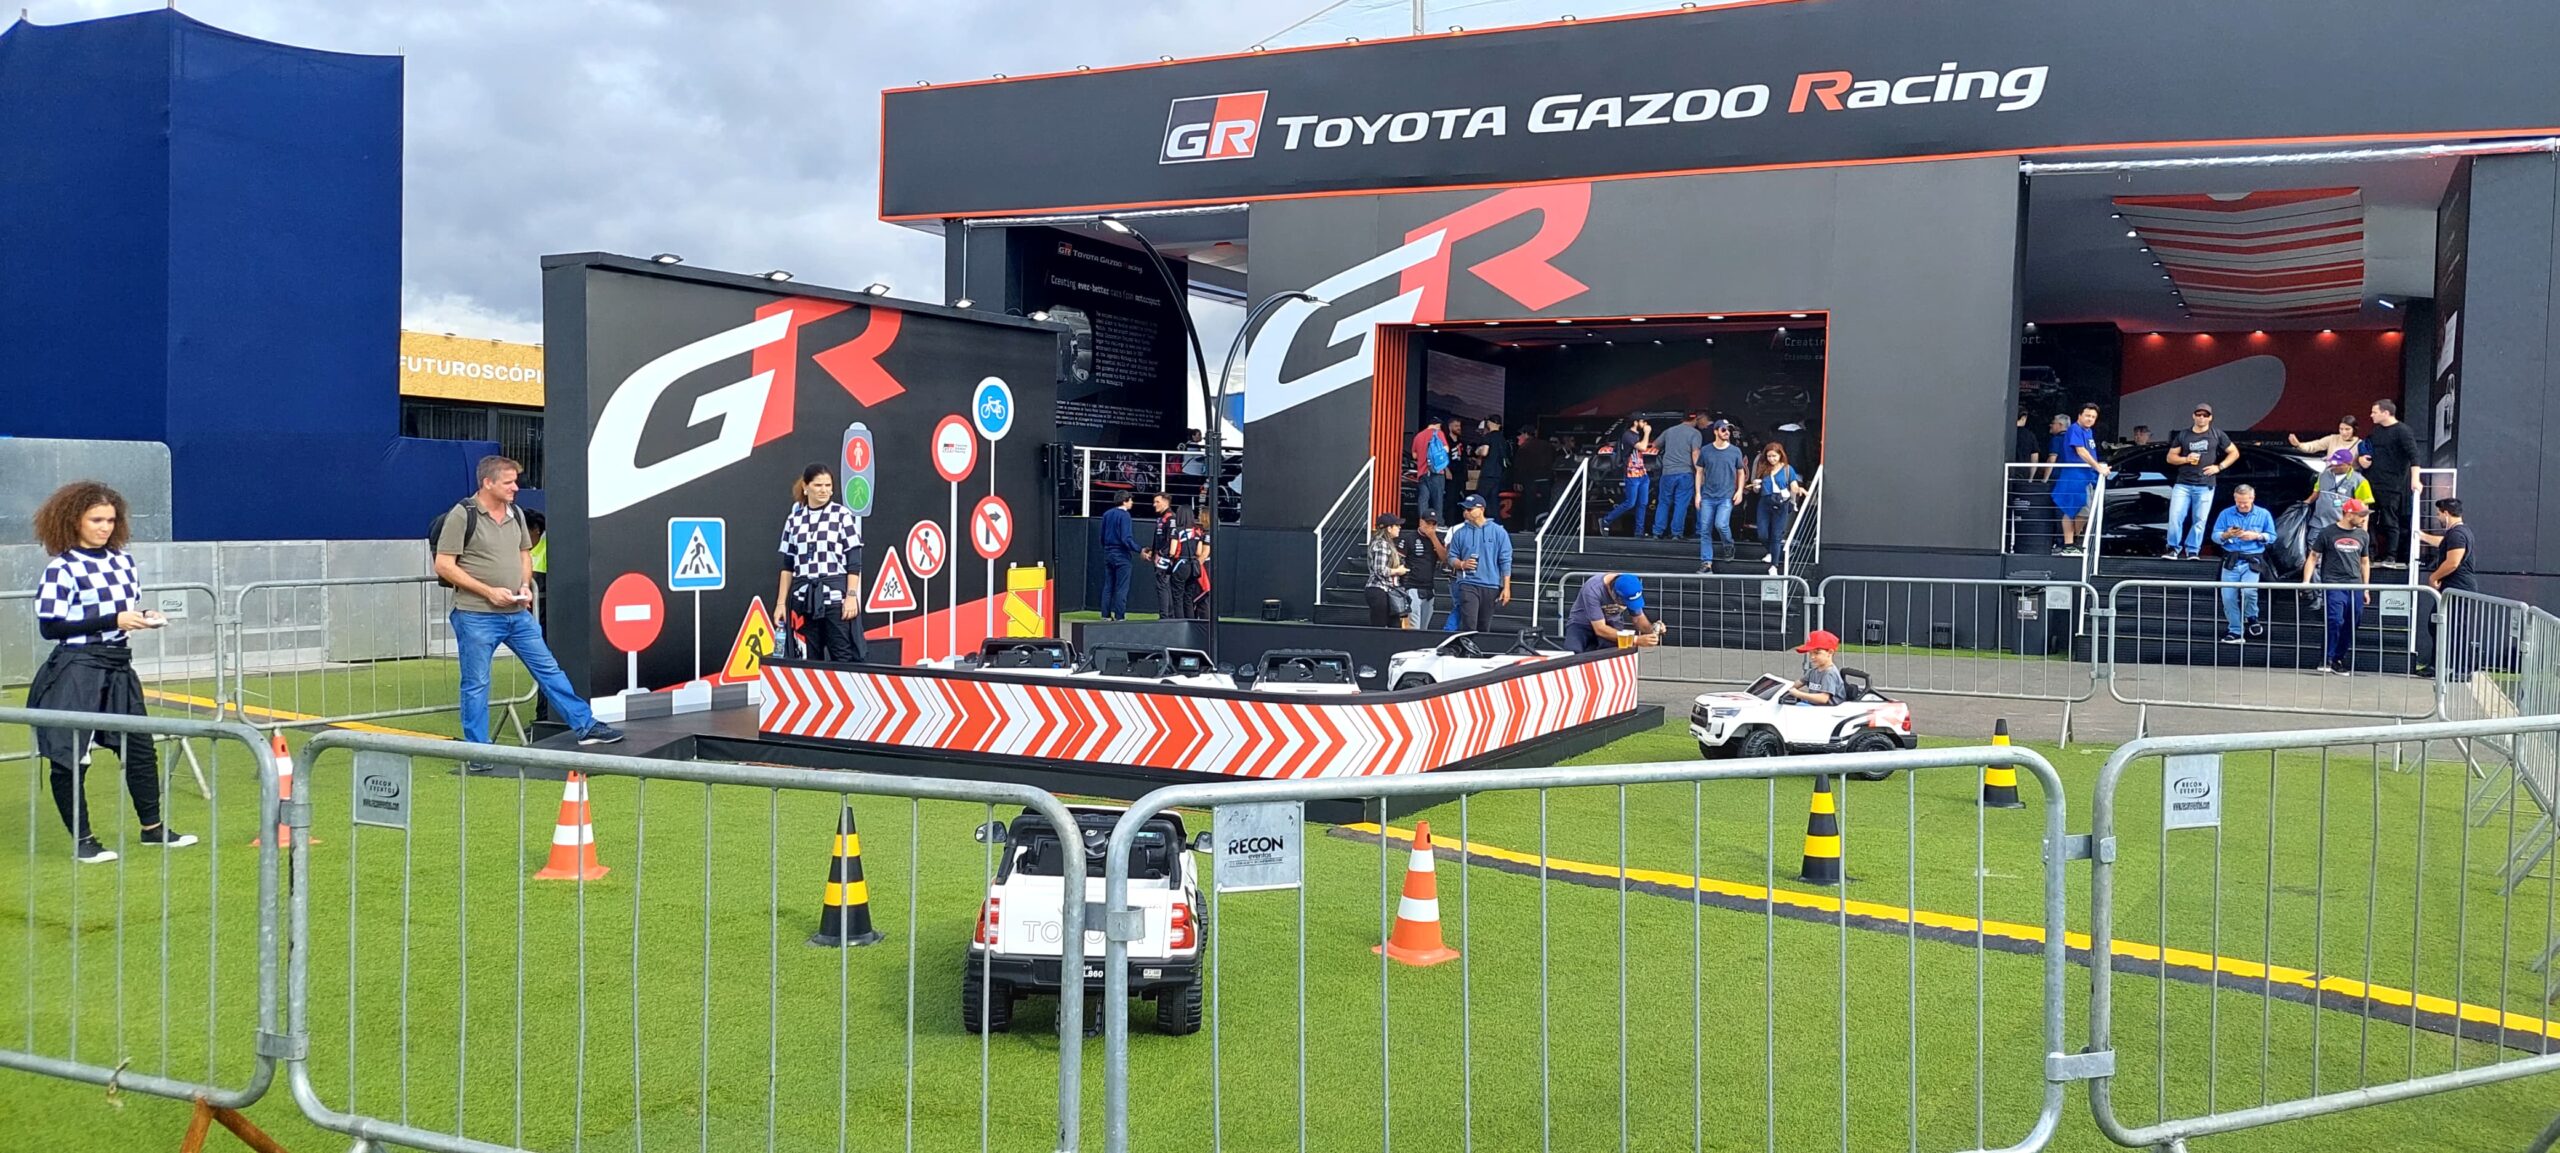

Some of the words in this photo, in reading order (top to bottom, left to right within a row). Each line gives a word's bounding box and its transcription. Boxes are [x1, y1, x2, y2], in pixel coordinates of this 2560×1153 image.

[1165, 117, 1257, 160] GR
[1276, 105, 1506, 150] TOYOTA
[1527, 83, 1770, 134] GAZOO
[1787, 62, 2050, 114] Racing
[1244, 182, 1592, 424] GR
[588, 296, 907, 519] GR
[1228, 835, 1283, 855] RECON
